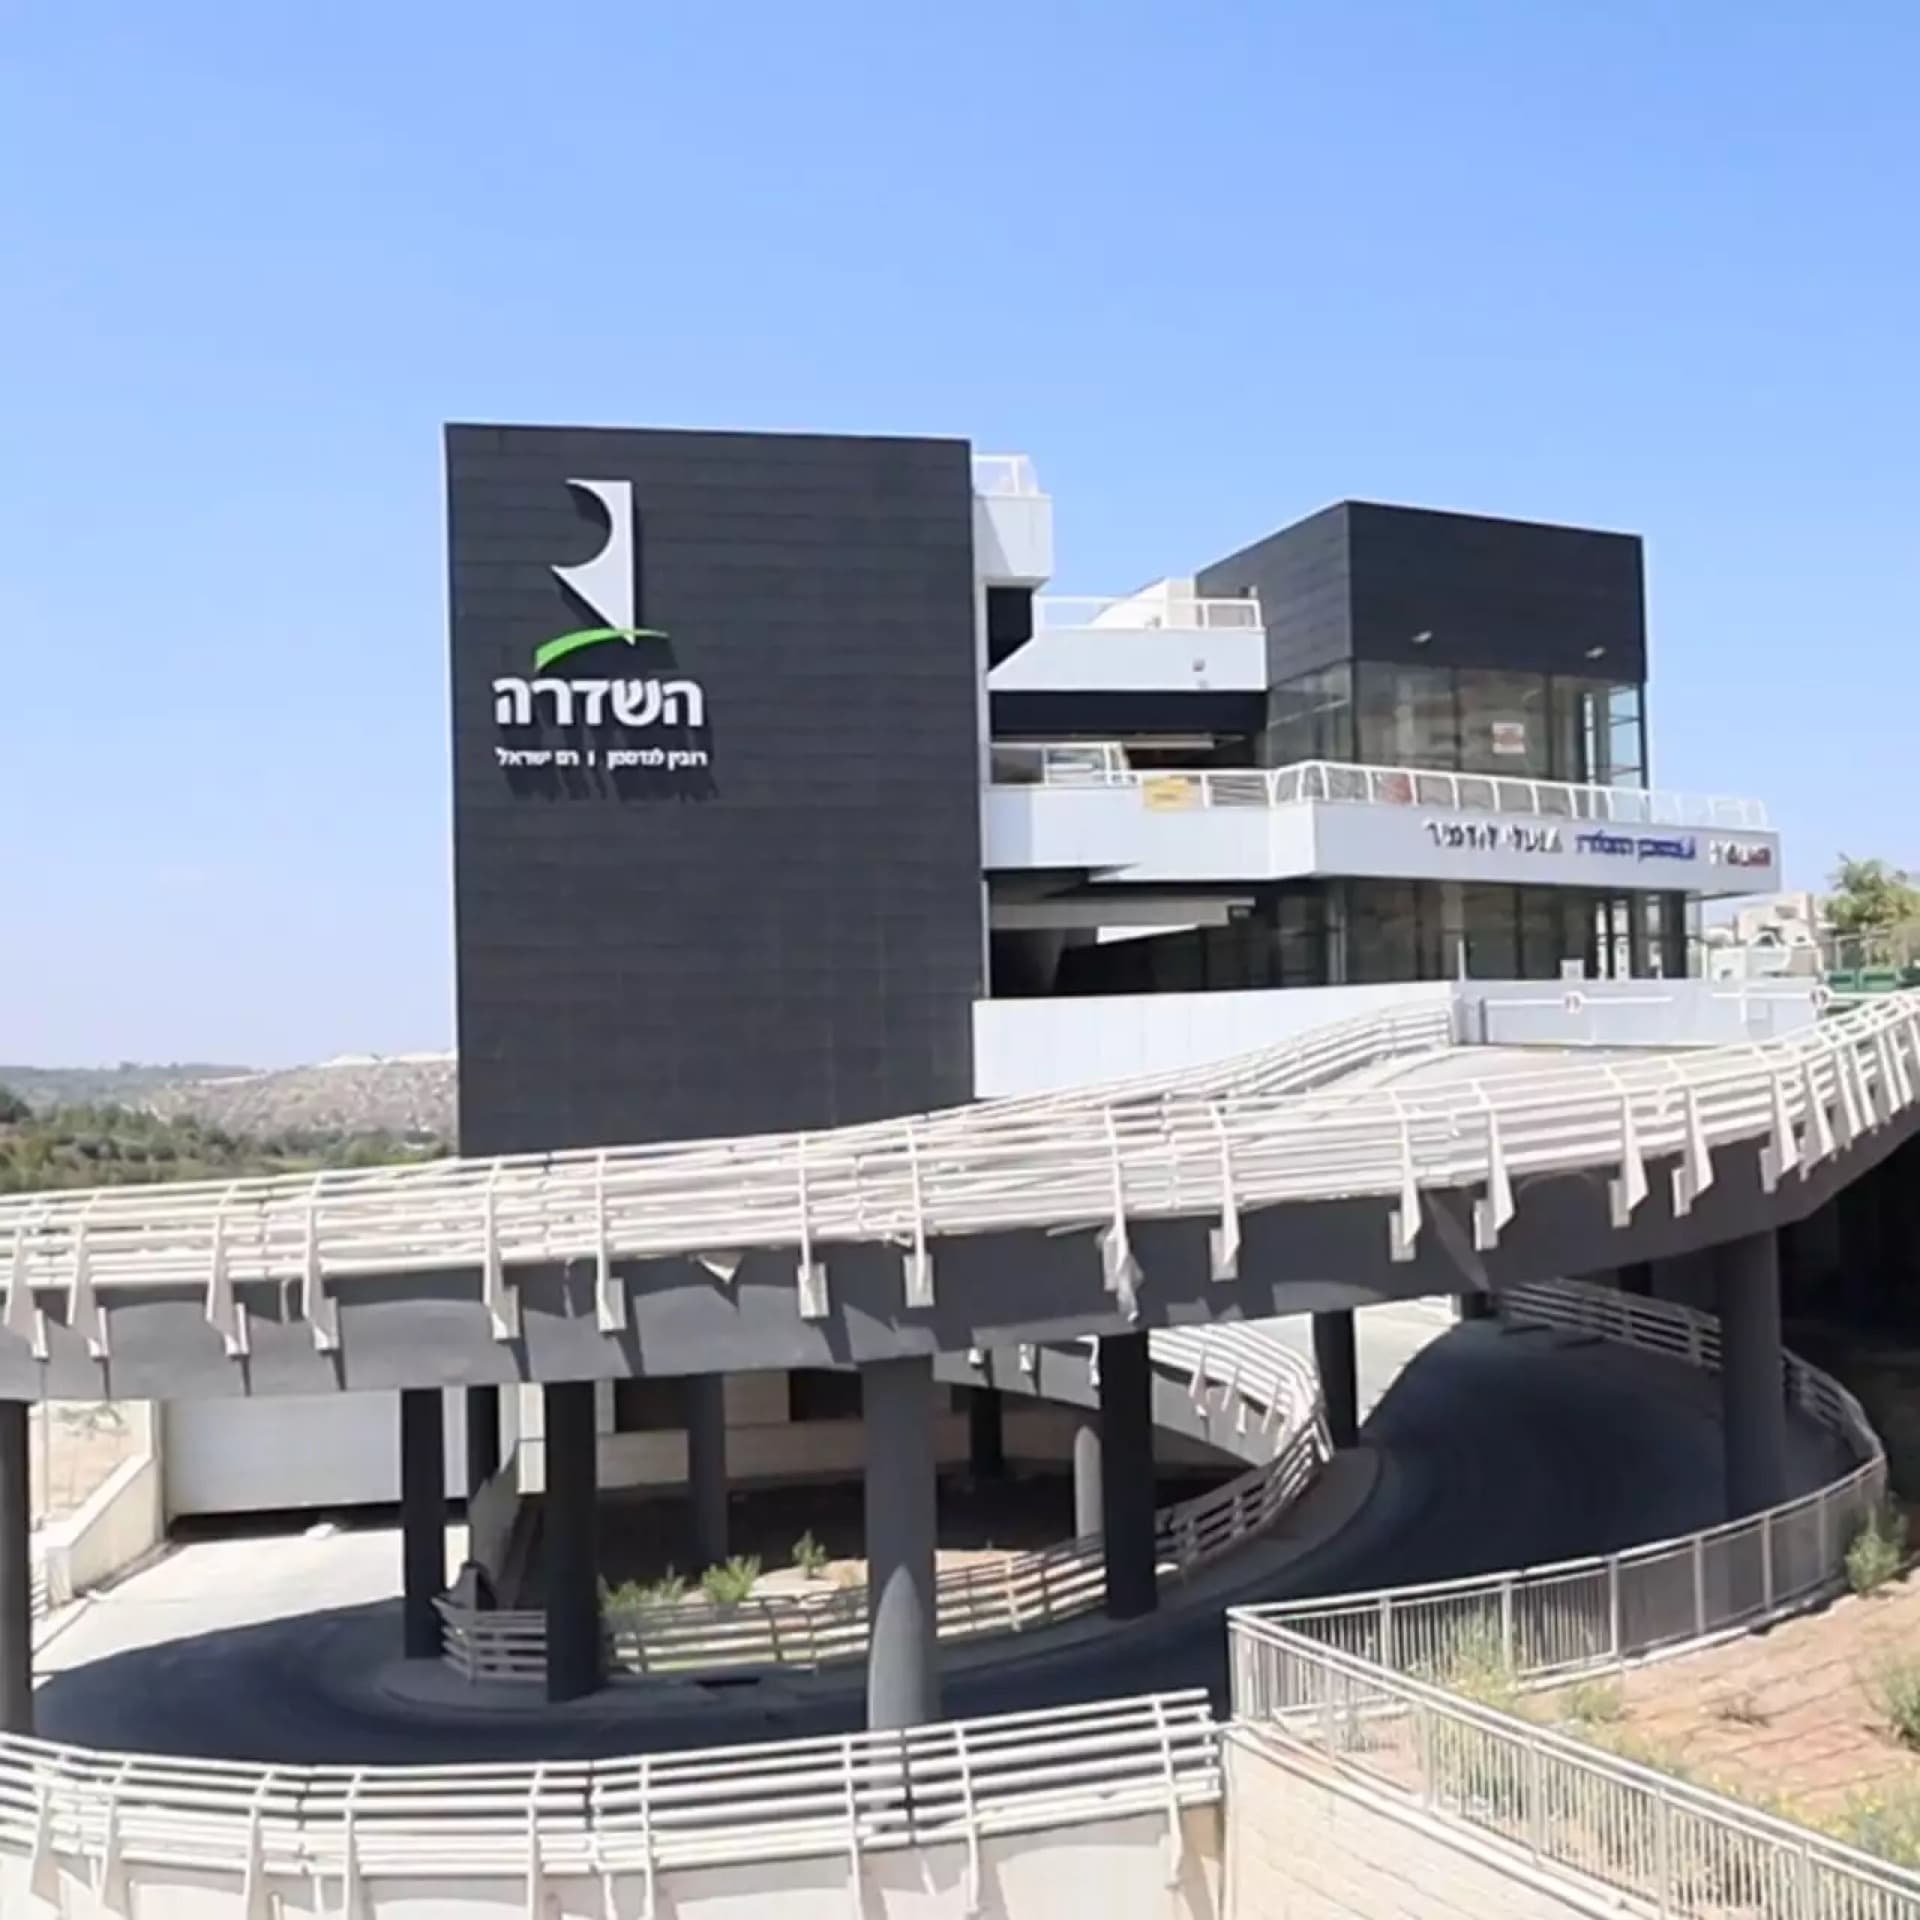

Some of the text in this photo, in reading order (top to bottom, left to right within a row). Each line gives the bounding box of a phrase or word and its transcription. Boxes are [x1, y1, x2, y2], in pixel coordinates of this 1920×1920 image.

[492, 677, 704, 727] השדרה
[495, 746, 553, 768] ישראל
[555, 749, 580, 767] רם
[667, 749, 708, 771] רובין
